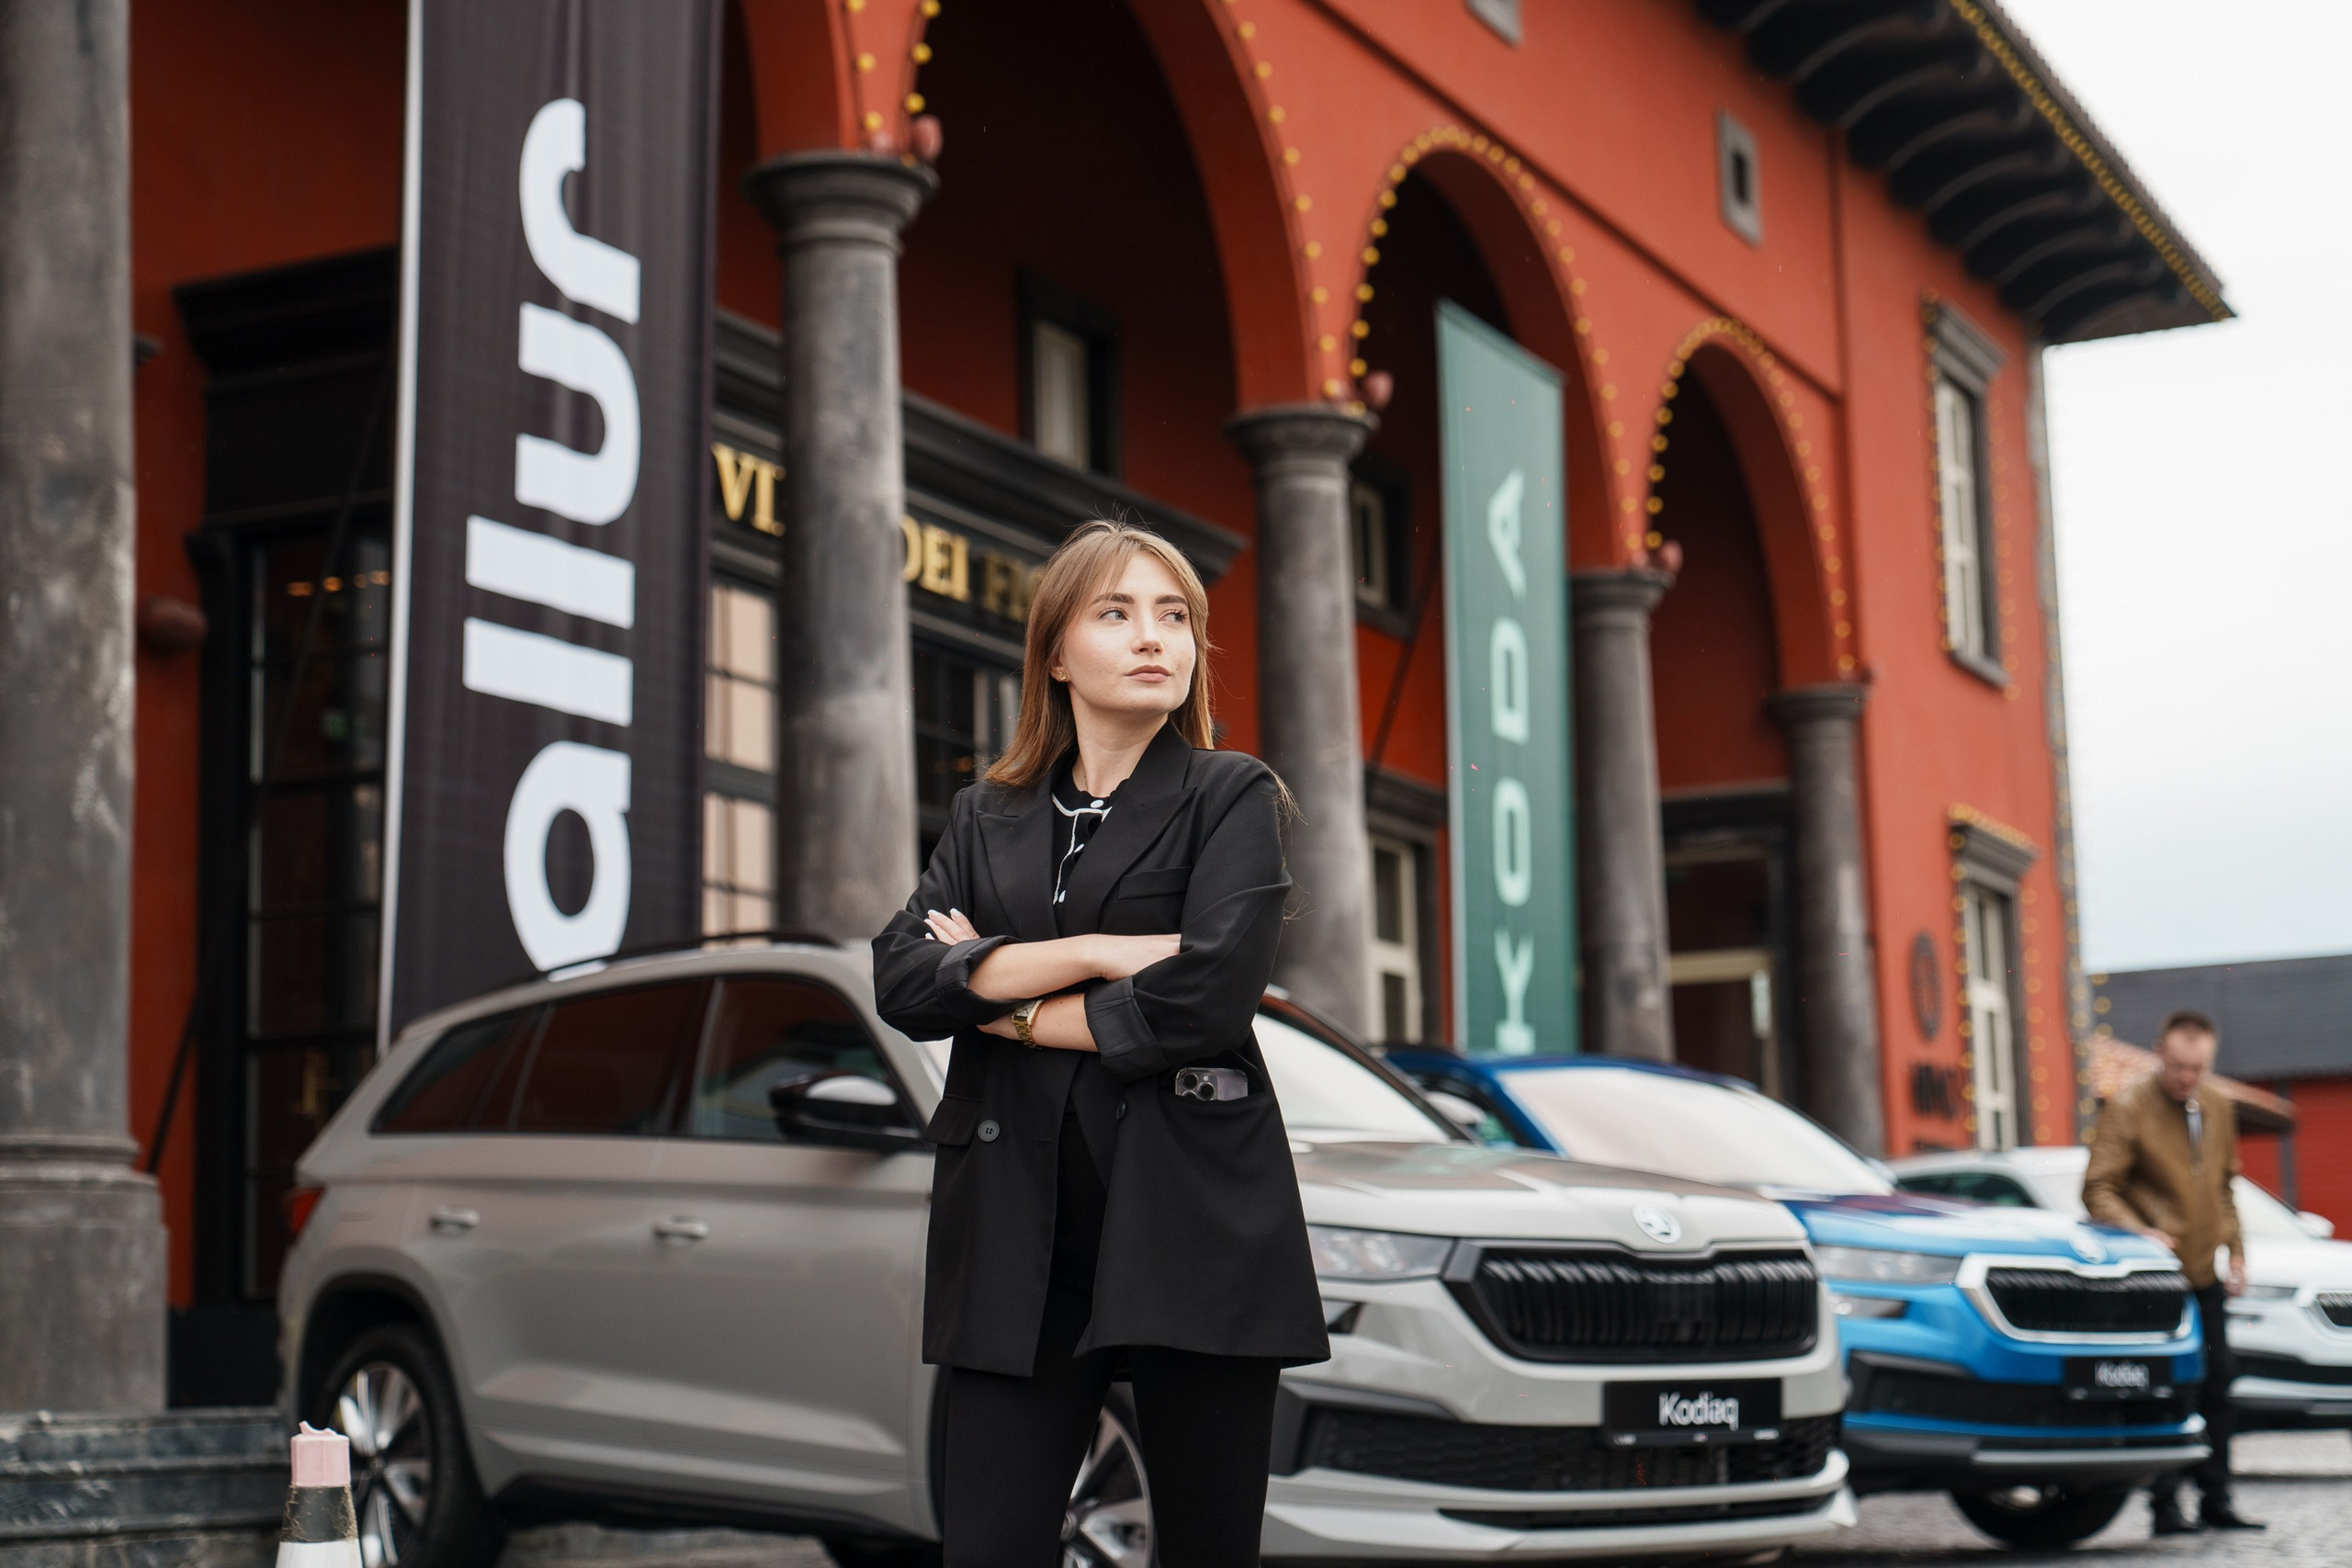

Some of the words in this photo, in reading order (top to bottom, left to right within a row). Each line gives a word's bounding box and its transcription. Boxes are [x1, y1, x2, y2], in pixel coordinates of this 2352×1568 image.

[462, 98, 641, 982] allur
[1486, 470, 1535, 1055] KODA
[1658, 1392, 1739, 1431] Kodiaq
